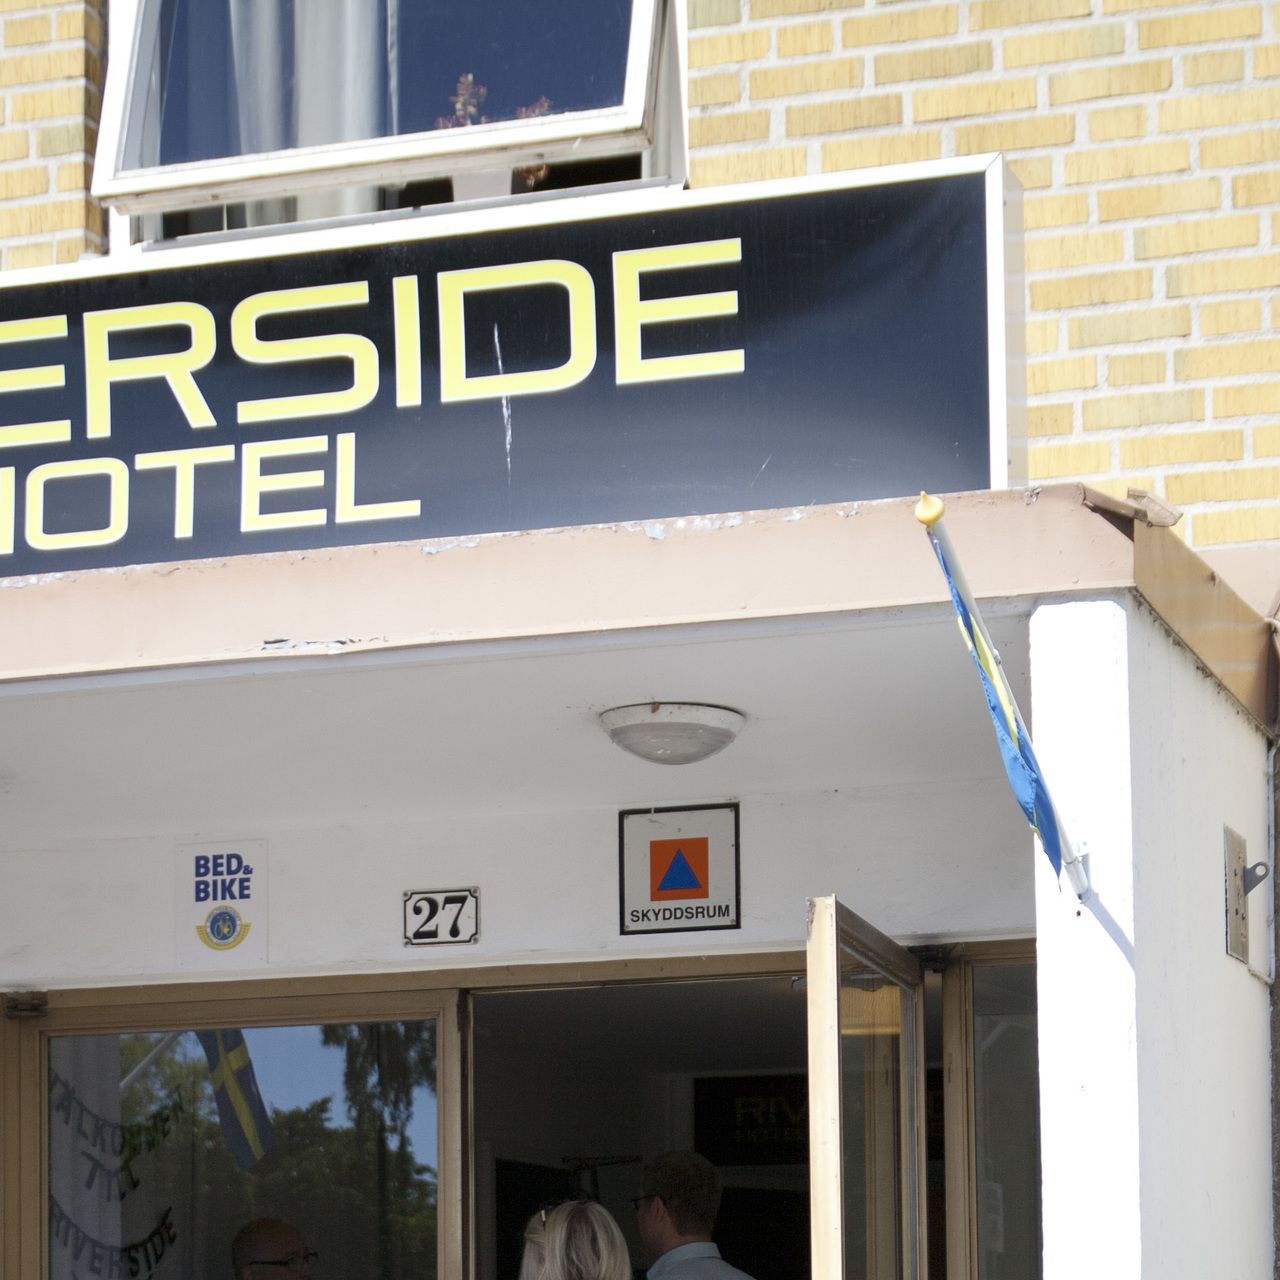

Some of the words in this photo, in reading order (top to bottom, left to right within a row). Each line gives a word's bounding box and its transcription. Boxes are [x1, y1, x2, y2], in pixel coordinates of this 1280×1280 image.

[194, 877, 251, 902] BIKE
[412, 895, 469, 940] 27
[630, 904, 730, 923] SKYDDSRUM
